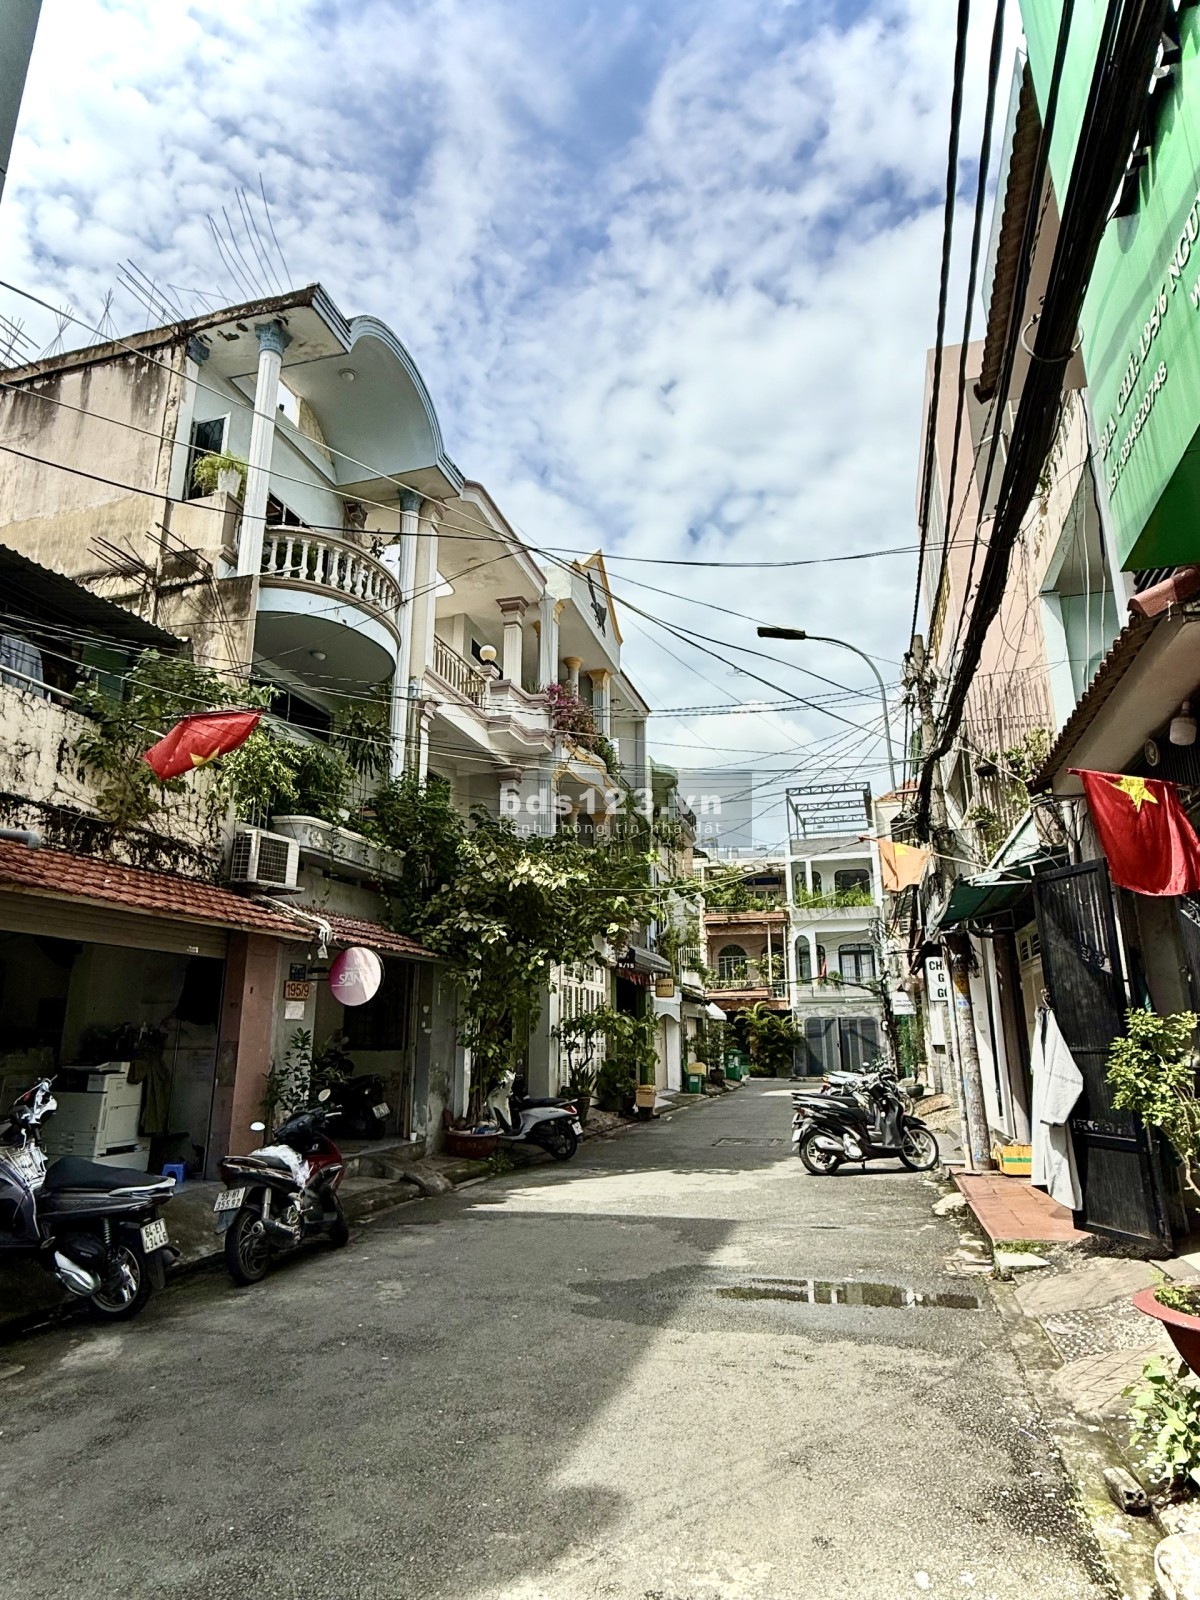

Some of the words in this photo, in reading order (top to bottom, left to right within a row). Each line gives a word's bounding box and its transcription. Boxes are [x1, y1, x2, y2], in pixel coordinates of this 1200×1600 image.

[1139, 283, 1168, 363] 195/6
[929, 961, 944, 971] CH
[287, 983, 309, 997] 195/9
